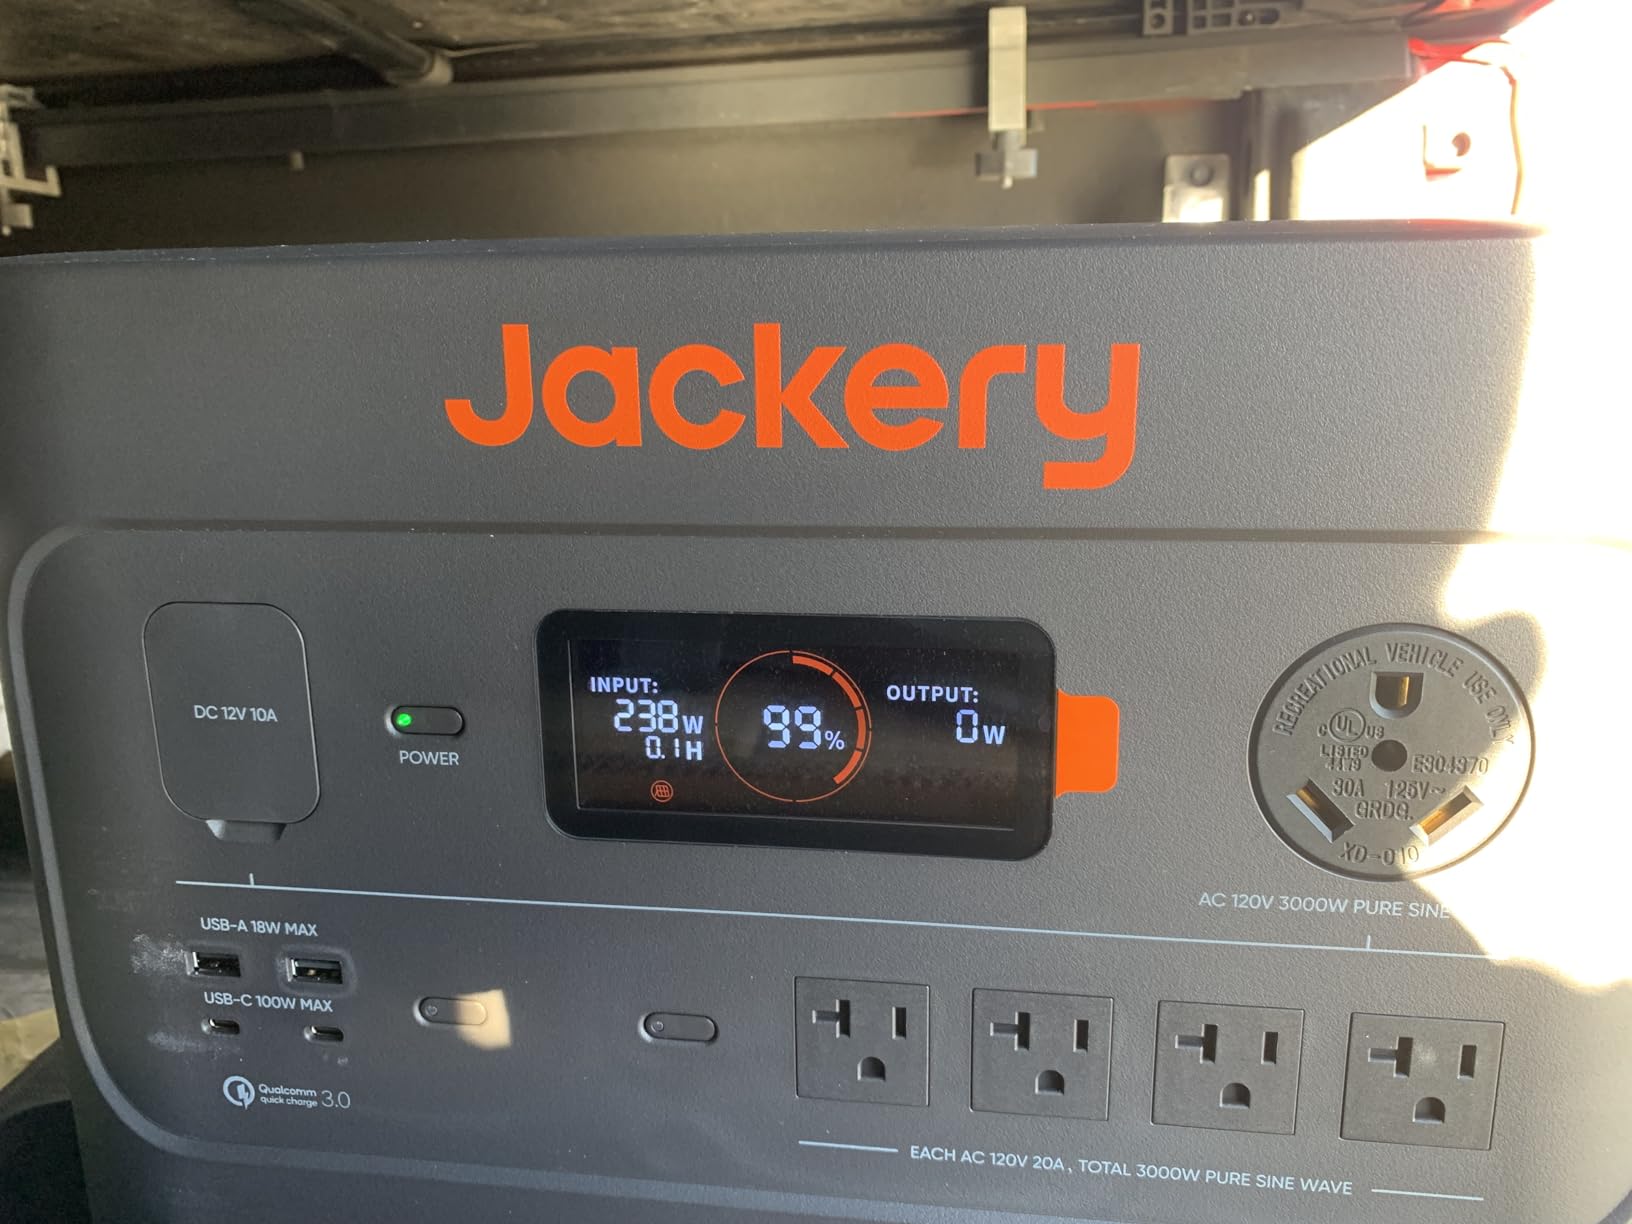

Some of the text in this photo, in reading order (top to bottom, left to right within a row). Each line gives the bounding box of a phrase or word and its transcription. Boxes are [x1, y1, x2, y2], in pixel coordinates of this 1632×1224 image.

[444, 321, 1142, 490] Jackery
[590, 677, 658, 694] INPUT:
[887, 684, 979, 703] OUTPUT:
[1274, 643, 1515, 745] RECREATIONAL VEHICLE USE ONLY
[193, 704, 278, 723] DC 12V 10A
[763, 705, 845, 750] 99%
[956, 709, 1005, 744] 0W
[399, 750, 460, 766] POWER
[1320, 744, 1369, 758] LISTED
[1332, 778, 1366, 797] 30A
[1198, 892, 1226, 907] AC
[1230, 893, 1275, 910] 120V
[1279, 895, 1349, 914] 3000W
[1353, 899, 1403, 917] PURE
[200, 917, 319, 938] USB-A 18W MAX
[204, 992, 333, 1013] USB-C 100W MAX
[258, 1083, 317, 1097] Qualcomm
[260, 1089, 351, 1109] quick charge 3.0
[910, 1145, 1353, 1195] EACH AC 120V 20A, TOTAL 3000W PURE SINE WAVE
